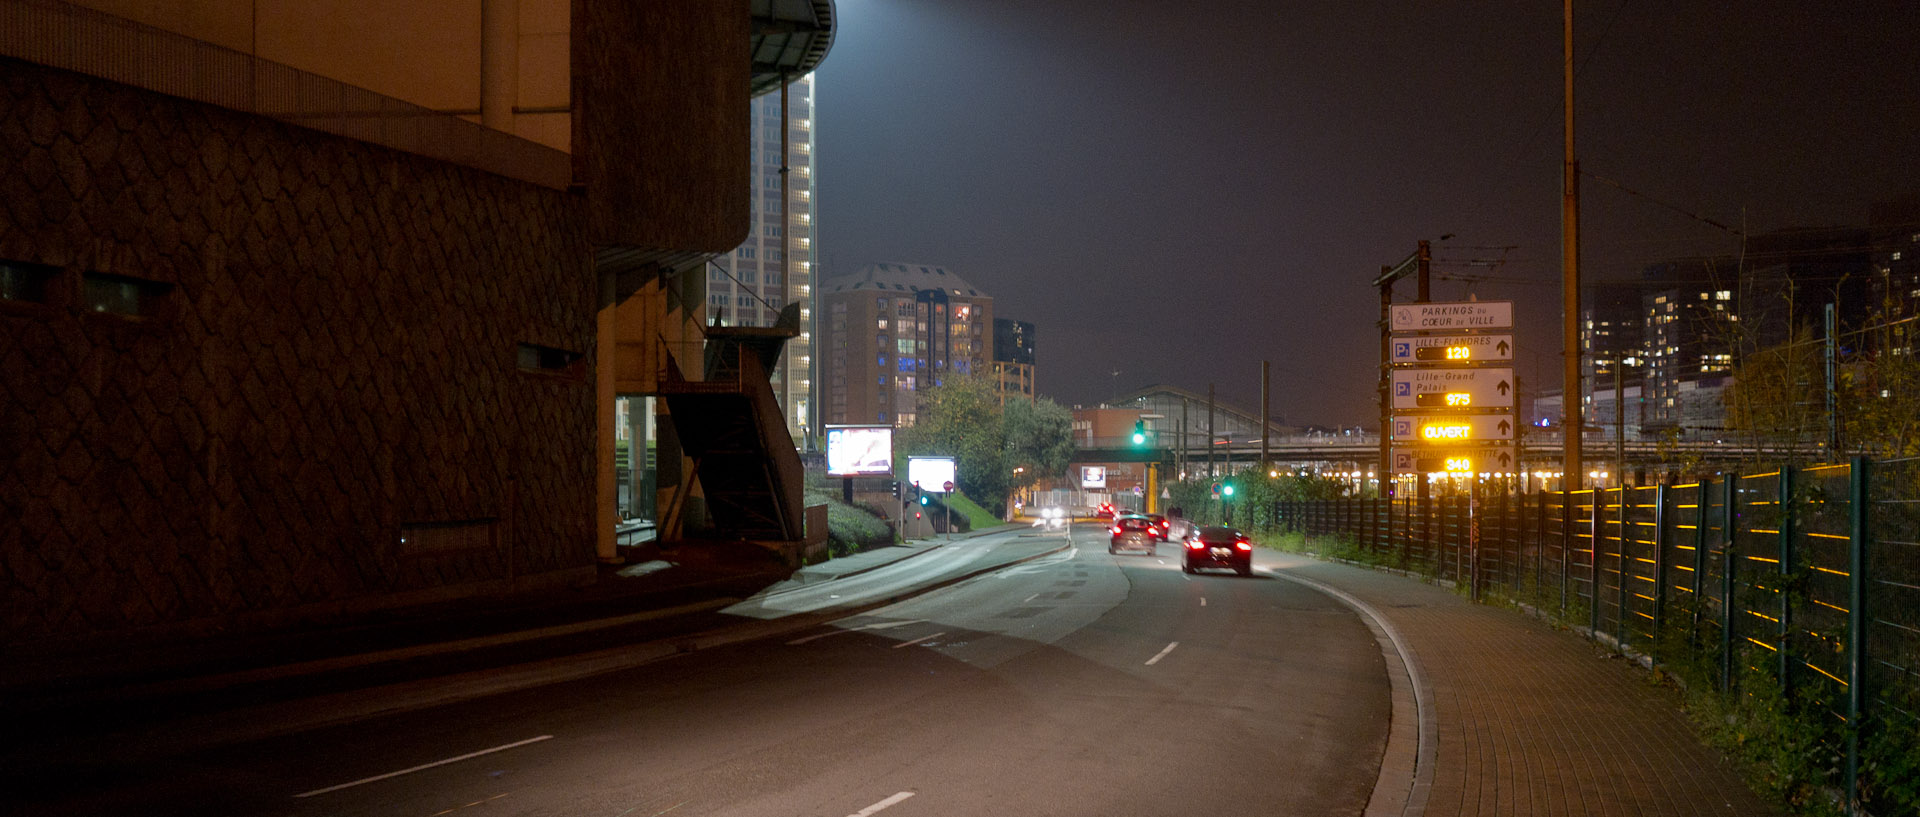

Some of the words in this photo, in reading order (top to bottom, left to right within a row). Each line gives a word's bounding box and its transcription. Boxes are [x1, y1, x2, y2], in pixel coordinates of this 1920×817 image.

[1422, 306, 1473, 316] PARKINGS
[1469, 316, 1495, 325] VILLE
[1415, 337, 1491, 347] LILLE-FLANDRES
[1446, 347, 1470, 359] 120
[1416, 372, 1475, 381] Lille-Grand
[1416, 383, 1447, 392] Palais
[1446, 393, 1471, 406] 975
[1424, 426, 1470, 438] OUVERT
[1446, 459, 1470, 470] 340
